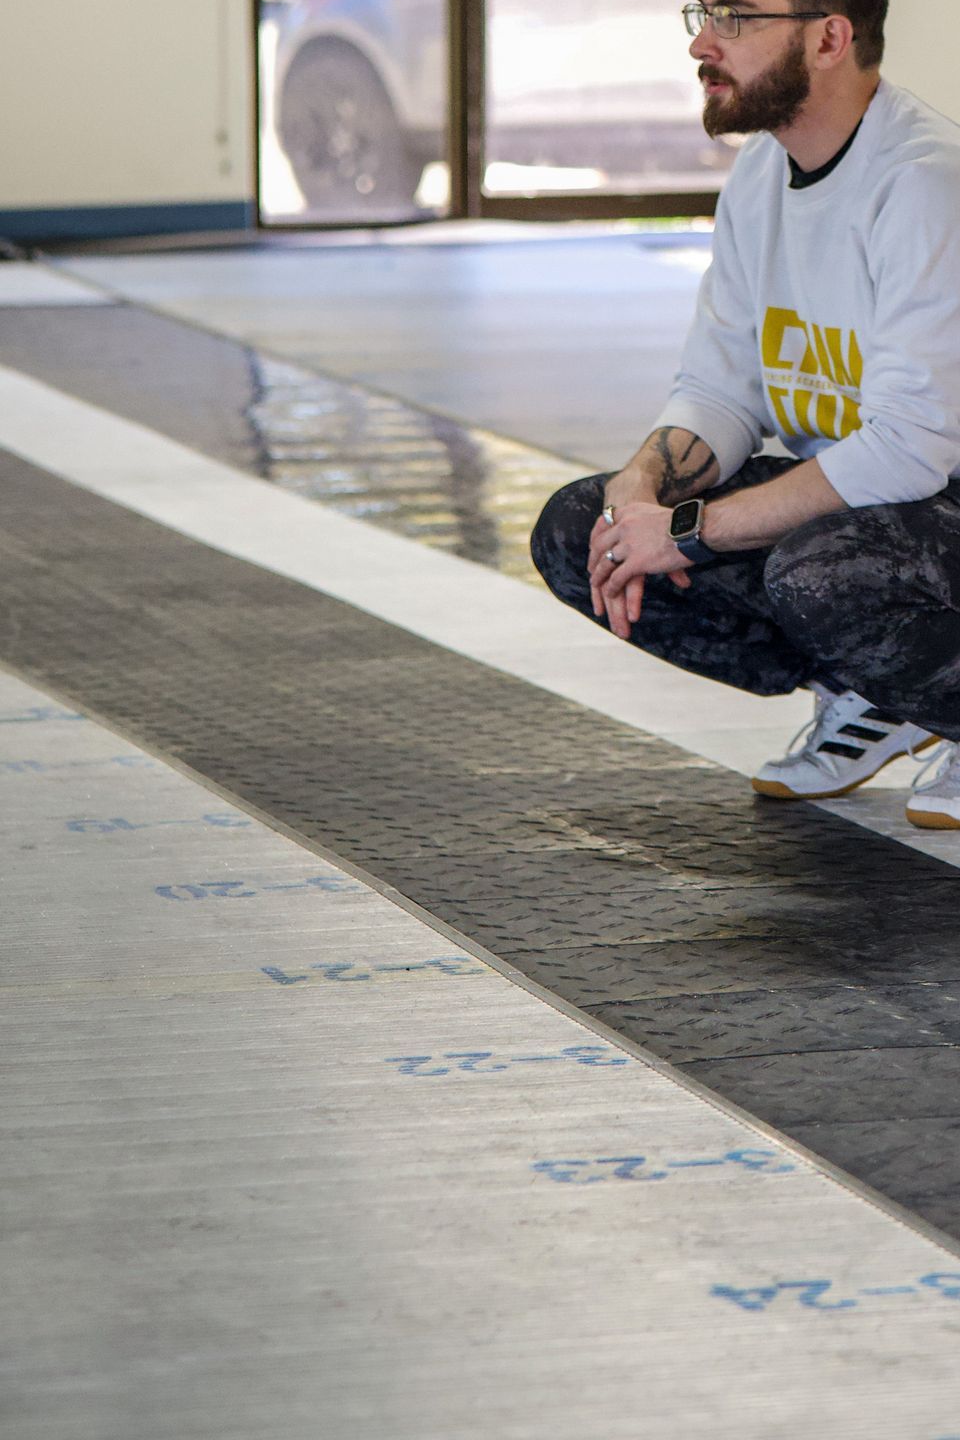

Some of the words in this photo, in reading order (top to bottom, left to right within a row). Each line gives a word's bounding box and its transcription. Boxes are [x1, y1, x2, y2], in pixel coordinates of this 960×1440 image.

[65, 813, 252, 833] 3-19
[153, 876, 360, 902] 3-20
[258, 956, 487, 987] 3-21
[384, 1046, 630, 1077] 3-22
[530, 1148, 796, 1185] 3-23
